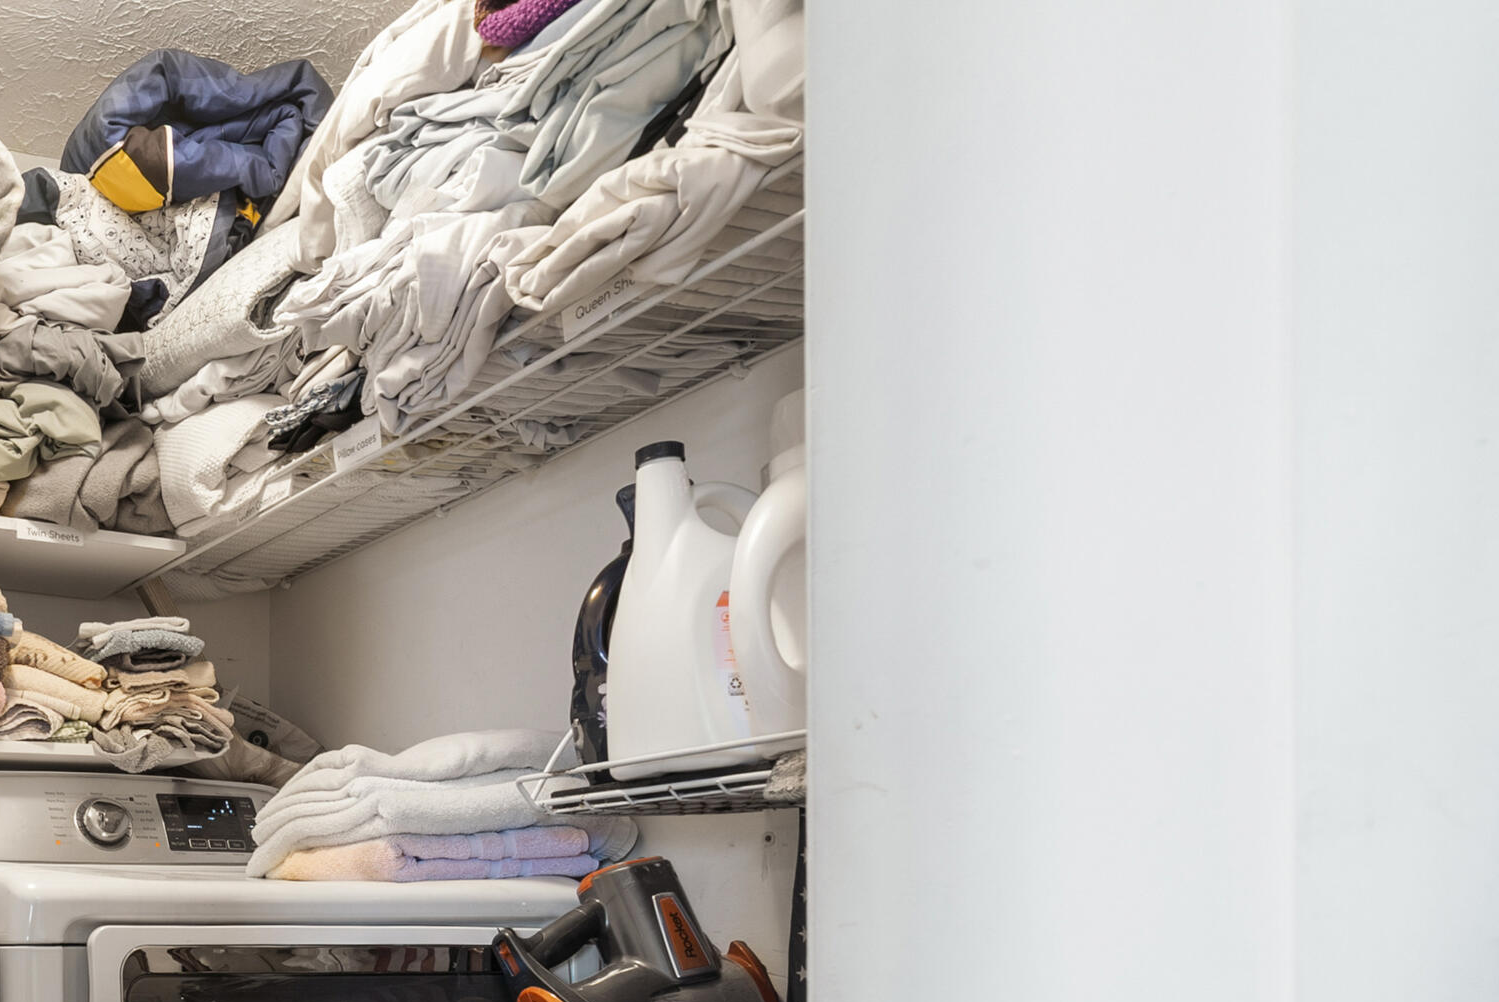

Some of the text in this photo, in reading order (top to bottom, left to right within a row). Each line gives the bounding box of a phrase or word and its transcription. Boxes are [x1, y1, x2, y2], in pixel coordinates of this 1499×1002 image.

[575, 291, 611, 320] Queen
[356, 433, 377, 452] cases
[27, 527, 81, 543] Twin Sheets
[669, 912, 697, 958] Rocket
